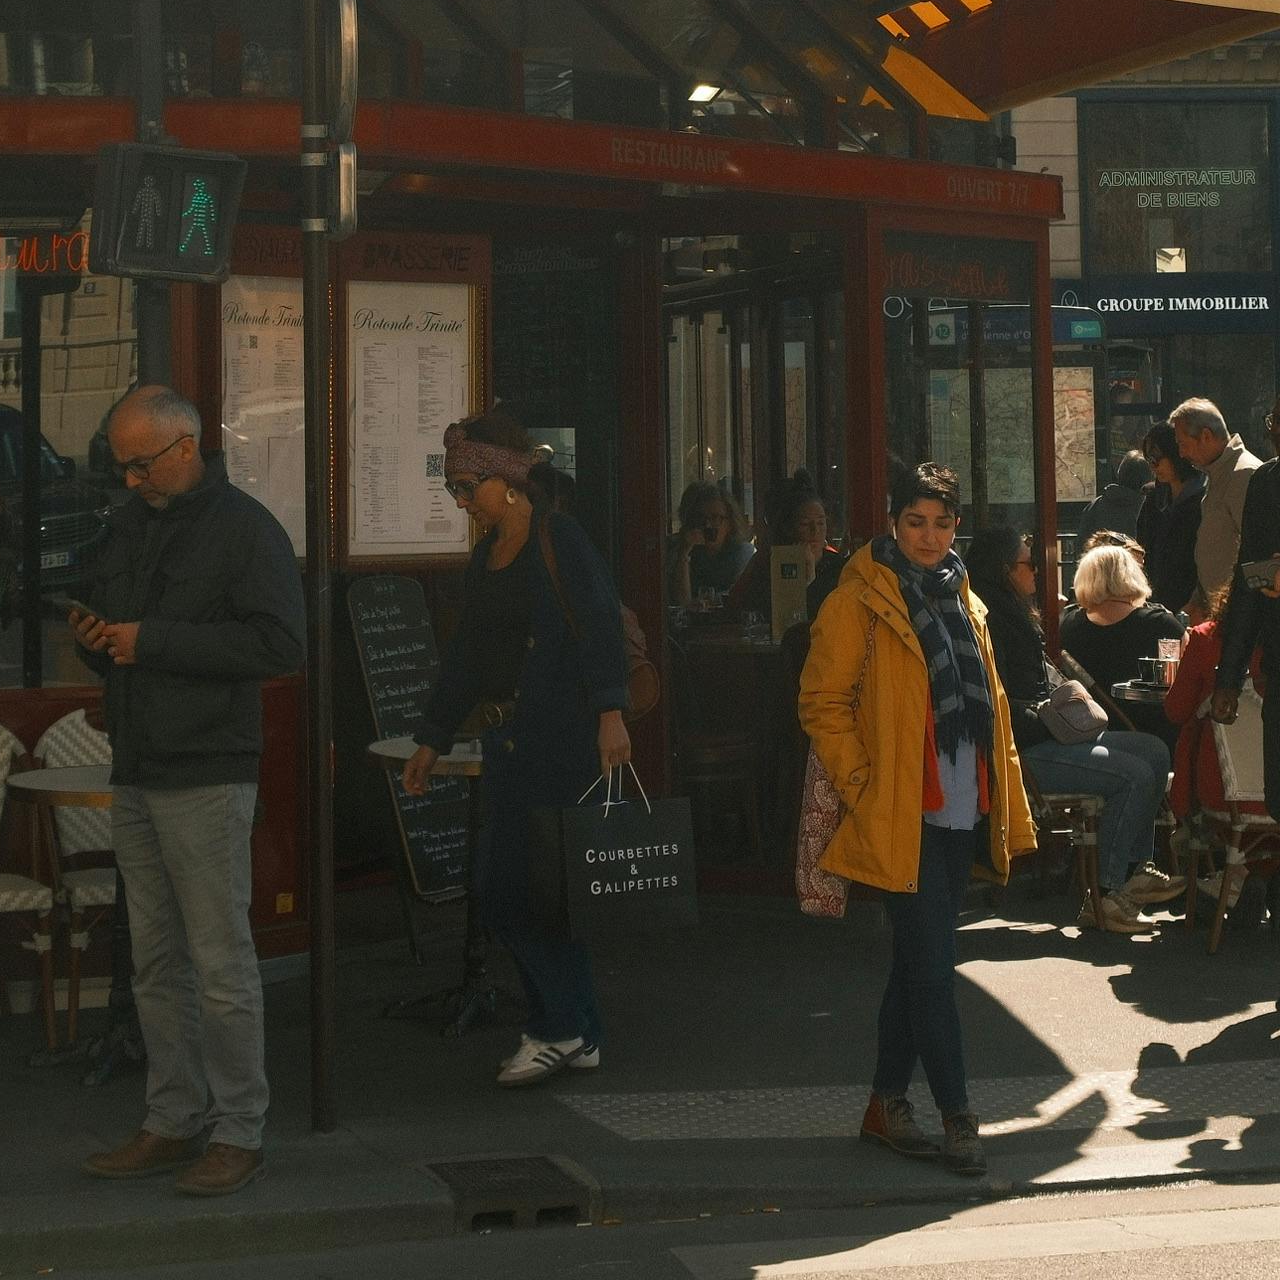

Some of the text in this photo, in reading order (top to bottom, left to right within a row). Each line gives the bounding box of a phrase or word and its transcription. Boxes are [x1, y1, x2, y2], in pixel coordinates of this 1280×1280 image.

[612, 137, 734, 174] RESTAURANT
[1098, 169, 1257, 187] ADMINISTRATEUR
[947, 176, 1029, 208] OUVERT 7/7
[1137, 191, 1221, 208] DE BIENS
[222, 301, 271, 327] Rotonde
[1096, 297, 1270, 312] GROUPE IMMOBILIER
[353, 308, 466, 334] Rotonde Trinité
[585, 843, 679, 864] COURBETTES
[630, 863, 639, 876] &
[590, 875, 679, 895] GALIPETTES
